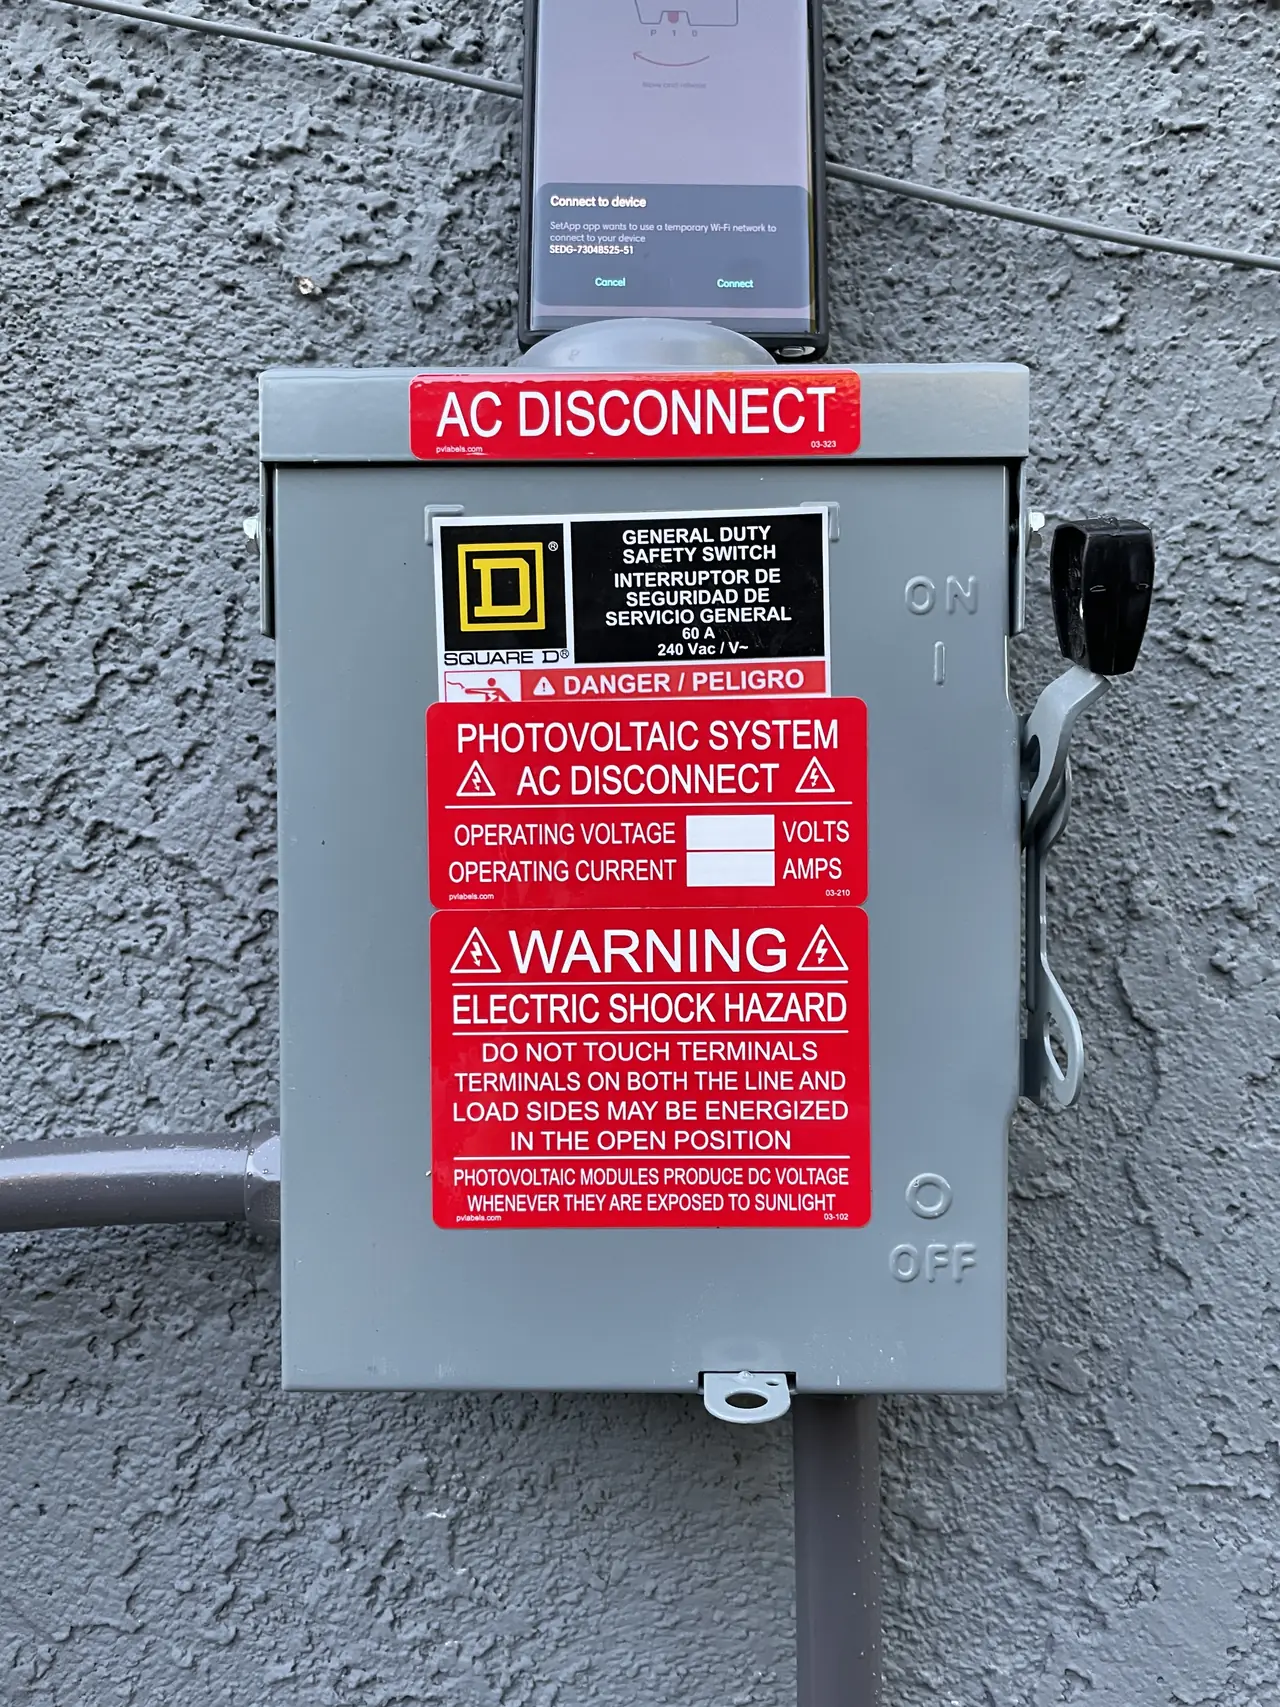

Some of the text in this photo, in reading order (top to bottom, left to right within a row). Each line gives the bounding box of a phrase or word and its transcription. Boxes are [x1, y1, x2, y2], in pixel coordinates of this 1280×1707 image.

[650, 29, 657, 37] P
[671, 29, 677, 37] 1
[550, 196, 647, 207] Connect to device
[550, 222, 580, 231] SetApp
[583, 223, 600, 231] app
[665, 223, 708, 233] temporary
[710, 223, 730, 231] Wi-Fi
[733, 224, 765, 232] network
[768, 224, 777, 232] to
[598, 236, 616, 244] your
[595, 277, 626, 286] Cancel
[717, 279, 754, 288] Connect
[437, 387, 836, 437] AC DISCONNECT
[436, 446, 484, 454] pvlabels.com
[810, 440, 837, 448] 03-323
[623, 526, 771, 544] GENERAL DUTY
[623, 545, 775, 564] SAFETY SWITCH
[473, 557, 530, 617] D
[615, 568, 780, 588] INTERRUPTOR DE
[626, 588, 769, 606] SEGURIDAD DE
[905, 575, 978, 615] ON
[606, 606, 792, 626] SERVICIO GENERAL
[683, 627, 715, 639] 60 A
[444, 651, 533, 665] SQUARE
[658, 643, 683, 656] 240
[688, 643, 715, 655] Vac
[720, 642, 724, 654] /
[564, 669, 804, 694] DANGER / PELIGRO
[458, 719, 837, 753] PHOTOVOLTAIC SYSTEM
[517, 763, 779, 795] AC DISCONNECT
[455, 821, 849, 846] OPERATING VOLTAGE VOLTS
[449, 858, 841, 883] OPERATING CURRENT AMPS
[825, 889, 851, 897] 03-210
[509, 928, 786, 973] WARNING
[453, 993, 846, 1024] ELECTRIC SHOCK HAZARD
[483, 1041, 817, 1062] DO NOT TOUCH TERMINALS
[455, 1071, 845, 1092] TERMINALS ON BOTH THE LINE AND
[454, 1101, 848, 1121] LOAD SIDES MAY BE ENERGIZED
[512, 1130, 790, 1150] IN THE OPEN POSITION
[454, 1168, 848, 1186] PHOTOVOLTAIC MODULES PRODUCE DC VOLTAGE
[468, 1194, 836, 1211] WHENEVER THEY ARE EXPOSED TO SUNLIGHT
[823, 1213, 849, 1221] 03-102
[889, 1244, 976, 1283] OFF
